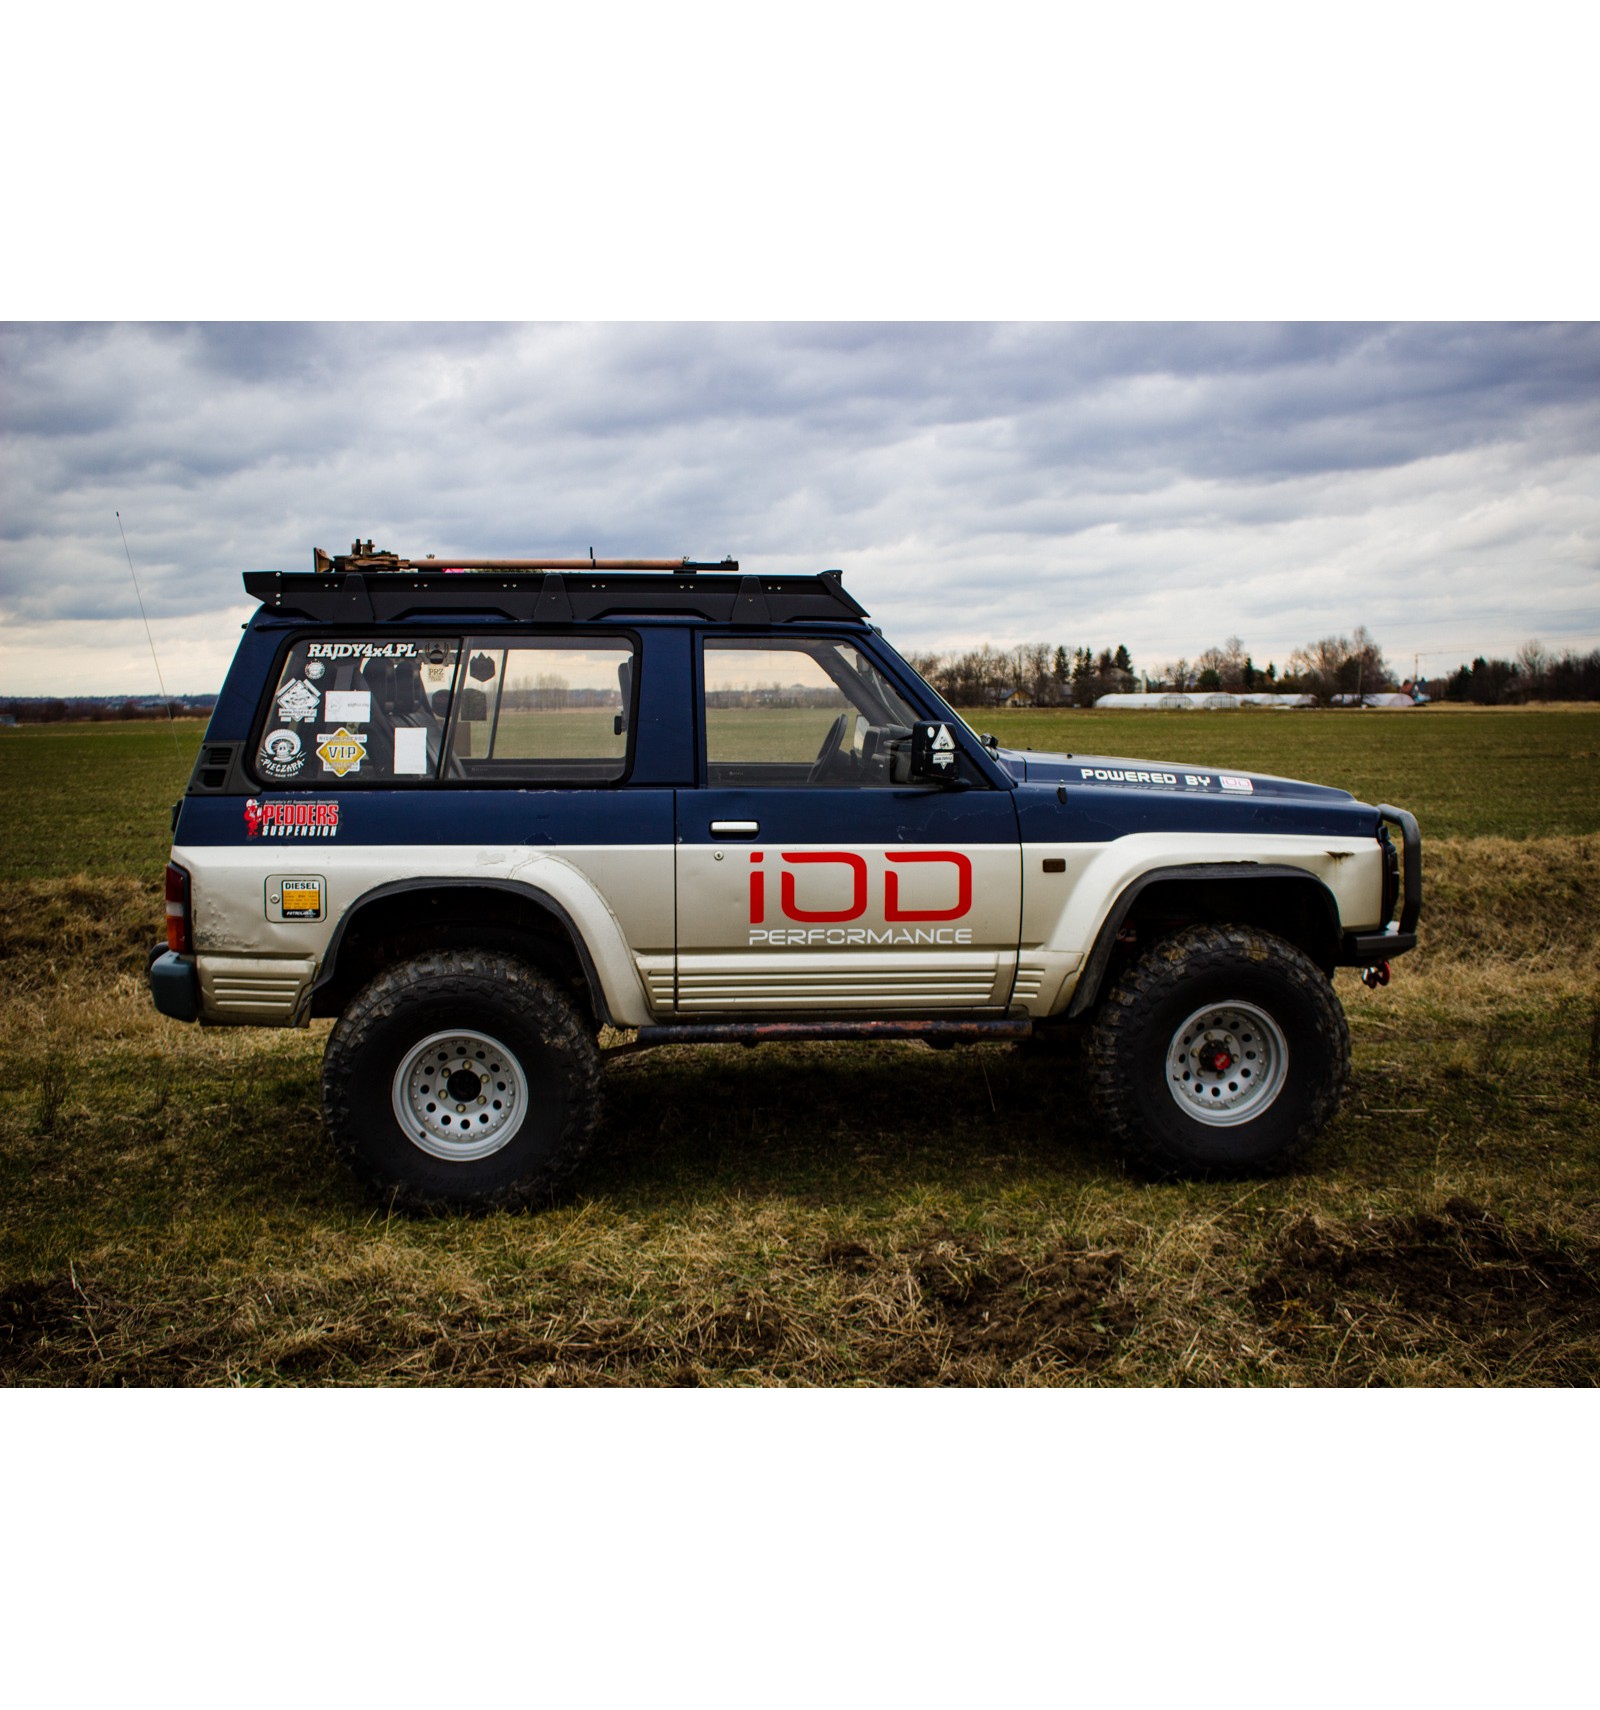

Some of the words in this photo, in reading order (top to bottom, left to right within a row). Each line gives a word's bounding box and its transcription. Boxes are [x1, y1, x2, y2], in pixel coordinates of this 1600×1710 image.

[306, 643, 417, 660] RAJDY4x4.PL
[328, 746, 356, 758] VIP
[262, 759, 304, 772] PIECZARA
[1080, 768, 1177, 785] POWERED
[1184, 775, 1211, 787] BY
[262, 804, 339, 826] PEDDERS
[262, 826, 337, 836] SUSPENSION
[285, 882, 317, 890] DIESEL
[749, 928, 972, 945] PERFORMANCE
